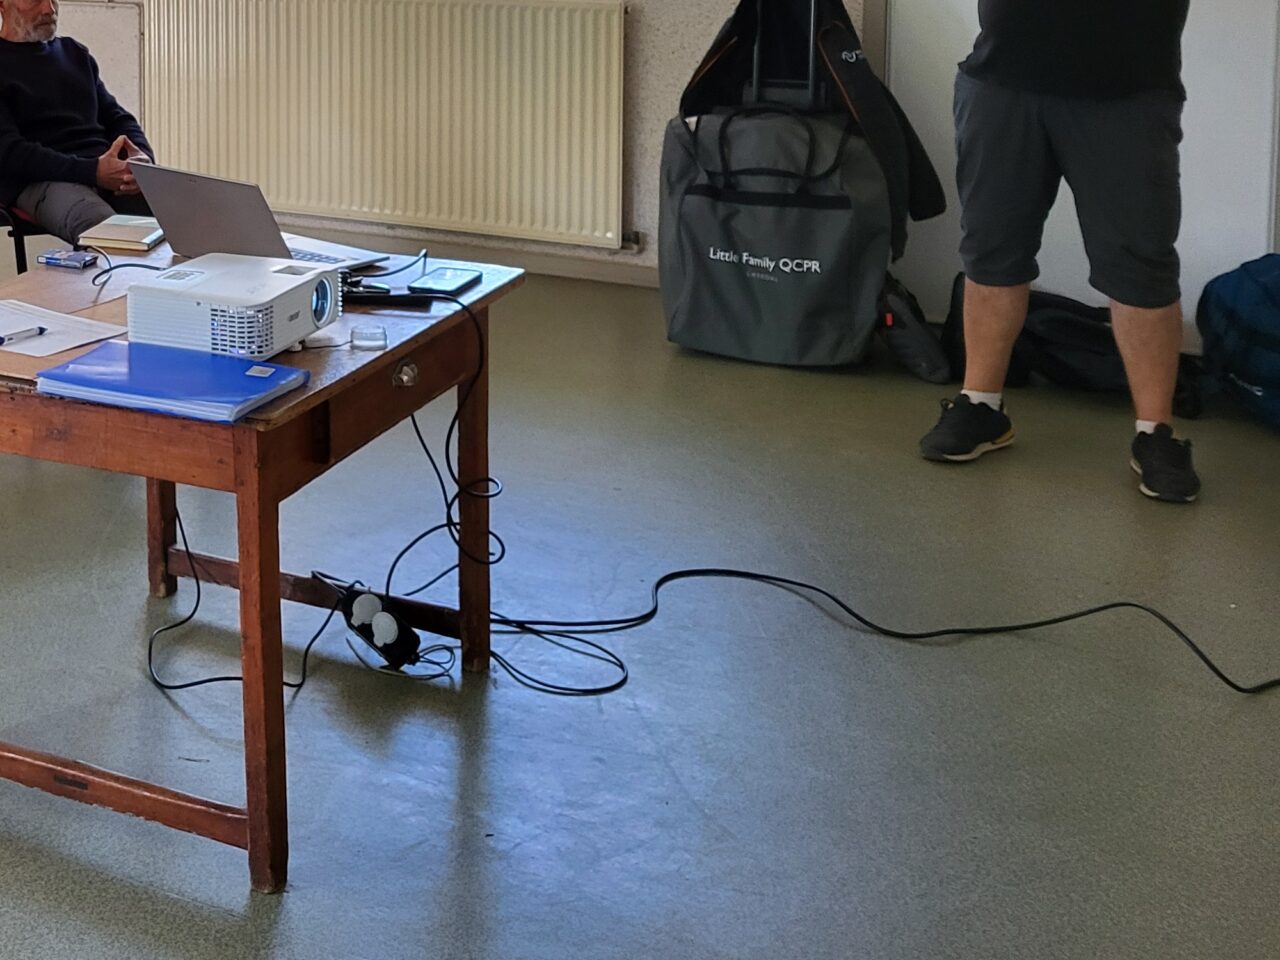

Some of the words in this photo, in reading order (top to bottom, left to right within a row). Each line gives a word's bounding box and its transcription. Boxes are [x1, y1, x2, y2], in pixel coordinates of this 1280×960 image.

[709, 247, 739, 263] Little
[742, 252, 776, 272] Family
[780, 258, 821, 273] QCPR
